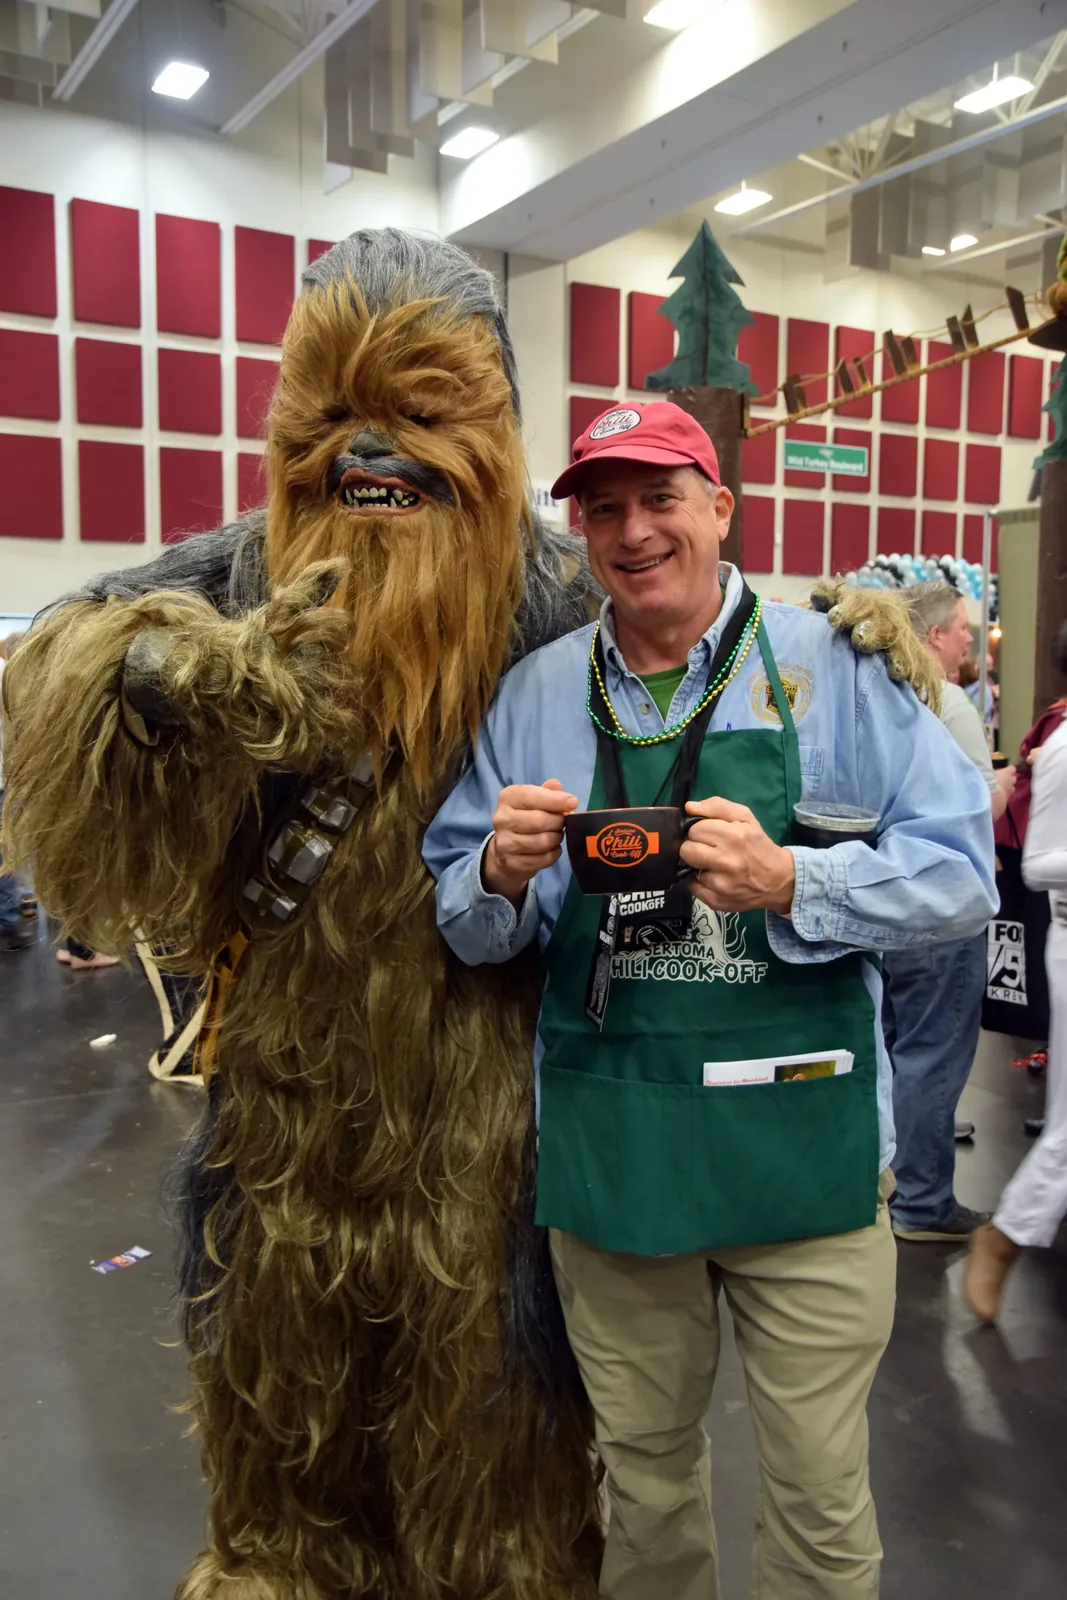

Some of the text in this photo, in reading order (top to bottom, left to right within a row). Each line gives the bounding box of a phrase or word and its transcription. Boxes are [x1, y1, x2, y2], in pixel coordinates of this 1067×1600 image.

[593, 414, 633, 437] Chili
[601, 830, 642, 857] Chili
[645, 942, 716, 960] SERTOMA
